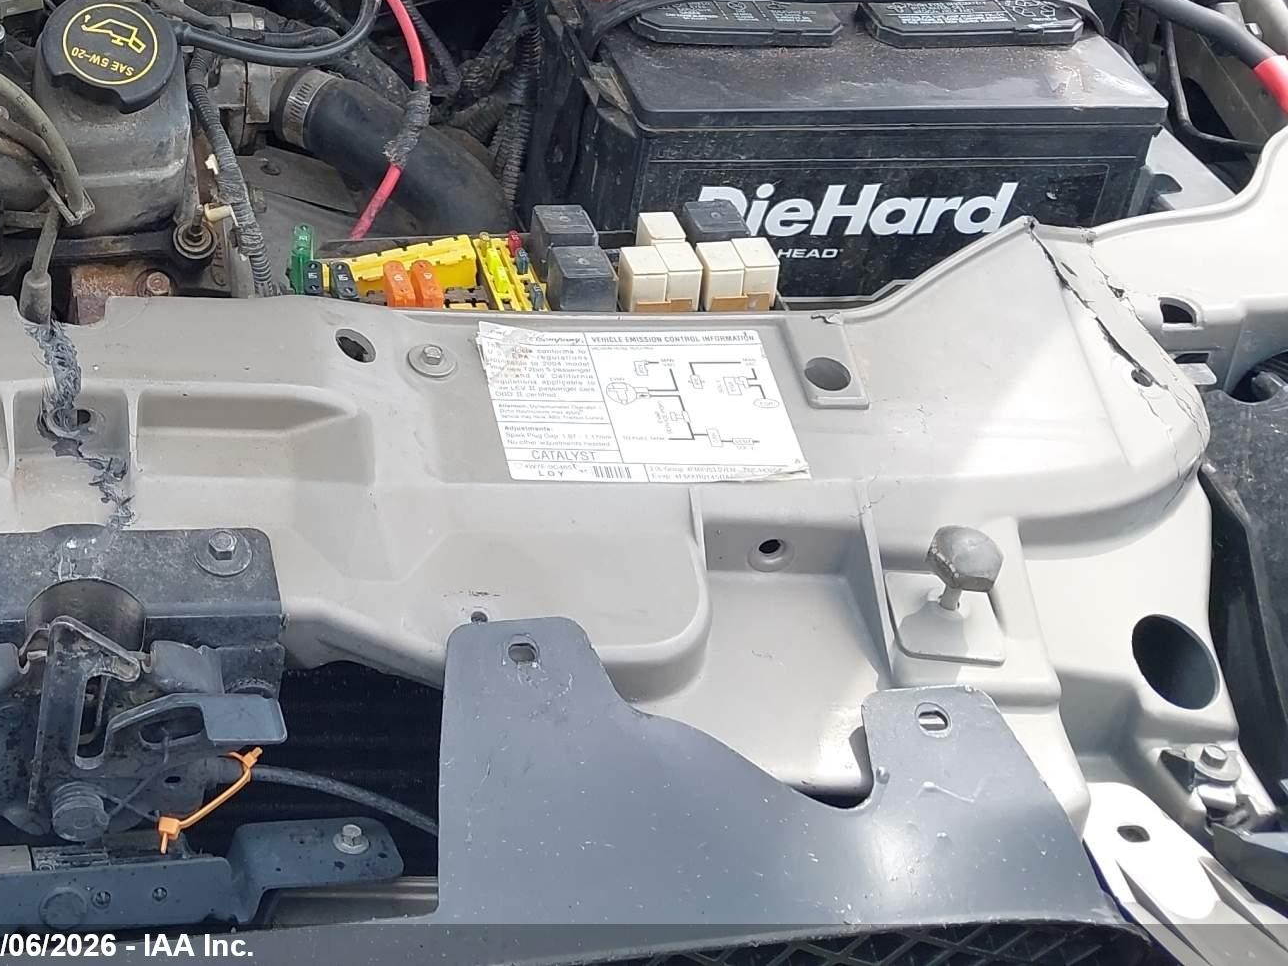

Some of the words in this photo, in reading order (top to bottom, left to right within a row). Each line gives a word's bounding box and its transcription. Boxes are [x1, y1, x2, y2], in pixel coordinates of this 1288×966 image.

[71, 46, 110, 68] 5W-20
[110, 59, 136, 77] SAE
[702, 334, 755, 342] INFORMATION
[531, 449, 597, 461] CATALYST
